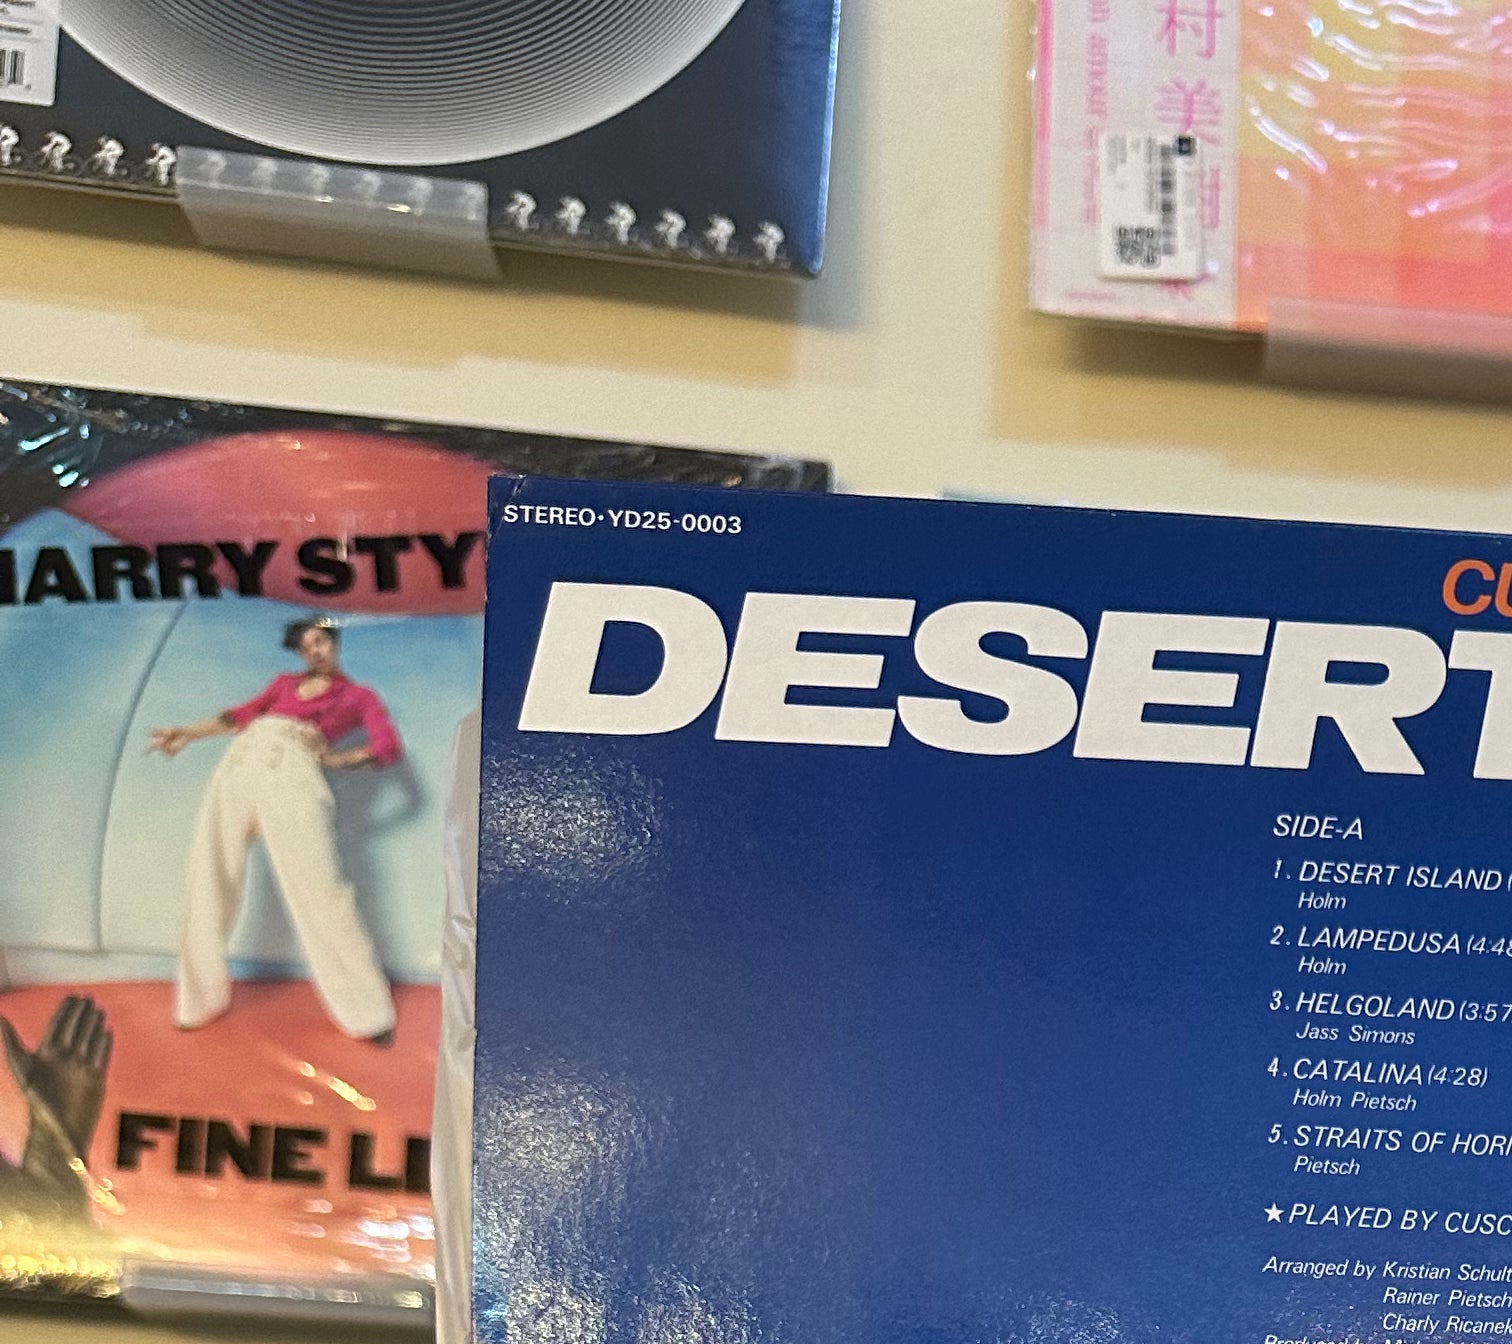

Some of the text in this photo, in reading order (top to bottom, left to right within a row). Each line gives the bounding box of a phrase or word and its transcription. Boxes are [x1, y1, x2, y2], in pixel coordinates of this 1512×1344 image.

[1273, 814, 1364, 840] SIDE-A
[1273, 859, 1291, 880] 1.
[1299, 861, 1400, 885] DESERT
[1406, 866, 1501, 891] ISLAND
[1298, 892, 1347, 910] Holm
[1270, 926, 1290, 946] 2.
[1298, 926, 1460, 954] LAMPEDUSA
[1298, 956, 1347, 975] Holm
[1270, 990, 1290, 1011] 3.
[1295, 992, 1454, 1021] HELGOLAND
[1296, 1022, 1415, 1045] Jass Simons
[1267, 1057, 1488, 1087] 4. CATALINA (4:28)
[1293, 1089, 1417, 1112] Holm Pietsch
[116, 1111, 326, 1187] FINE
[1268, 1124, 1288, 1145] 5.
[1293, 1125, 1402, 1151] STRAITS
[1411, 1131, 1446, 1153] OF
[1294, 1156, 1361, 1176] Pietsch
[1288, 1203, 1392, 1231] PLAYED
[1401, 1209, 1439, 1233] BY
[1262, 1256, 1348, 1279] Arranged
[1354, 1260, 1376, 1280] by
[1383, 1260, 1451, 1281] Kristian
[1383, 1286, 1442, 1306] Rainer
[1448, 1289, 1512, 1310] Pietsch
[1382, 1312, 1440, 1336] Charly
